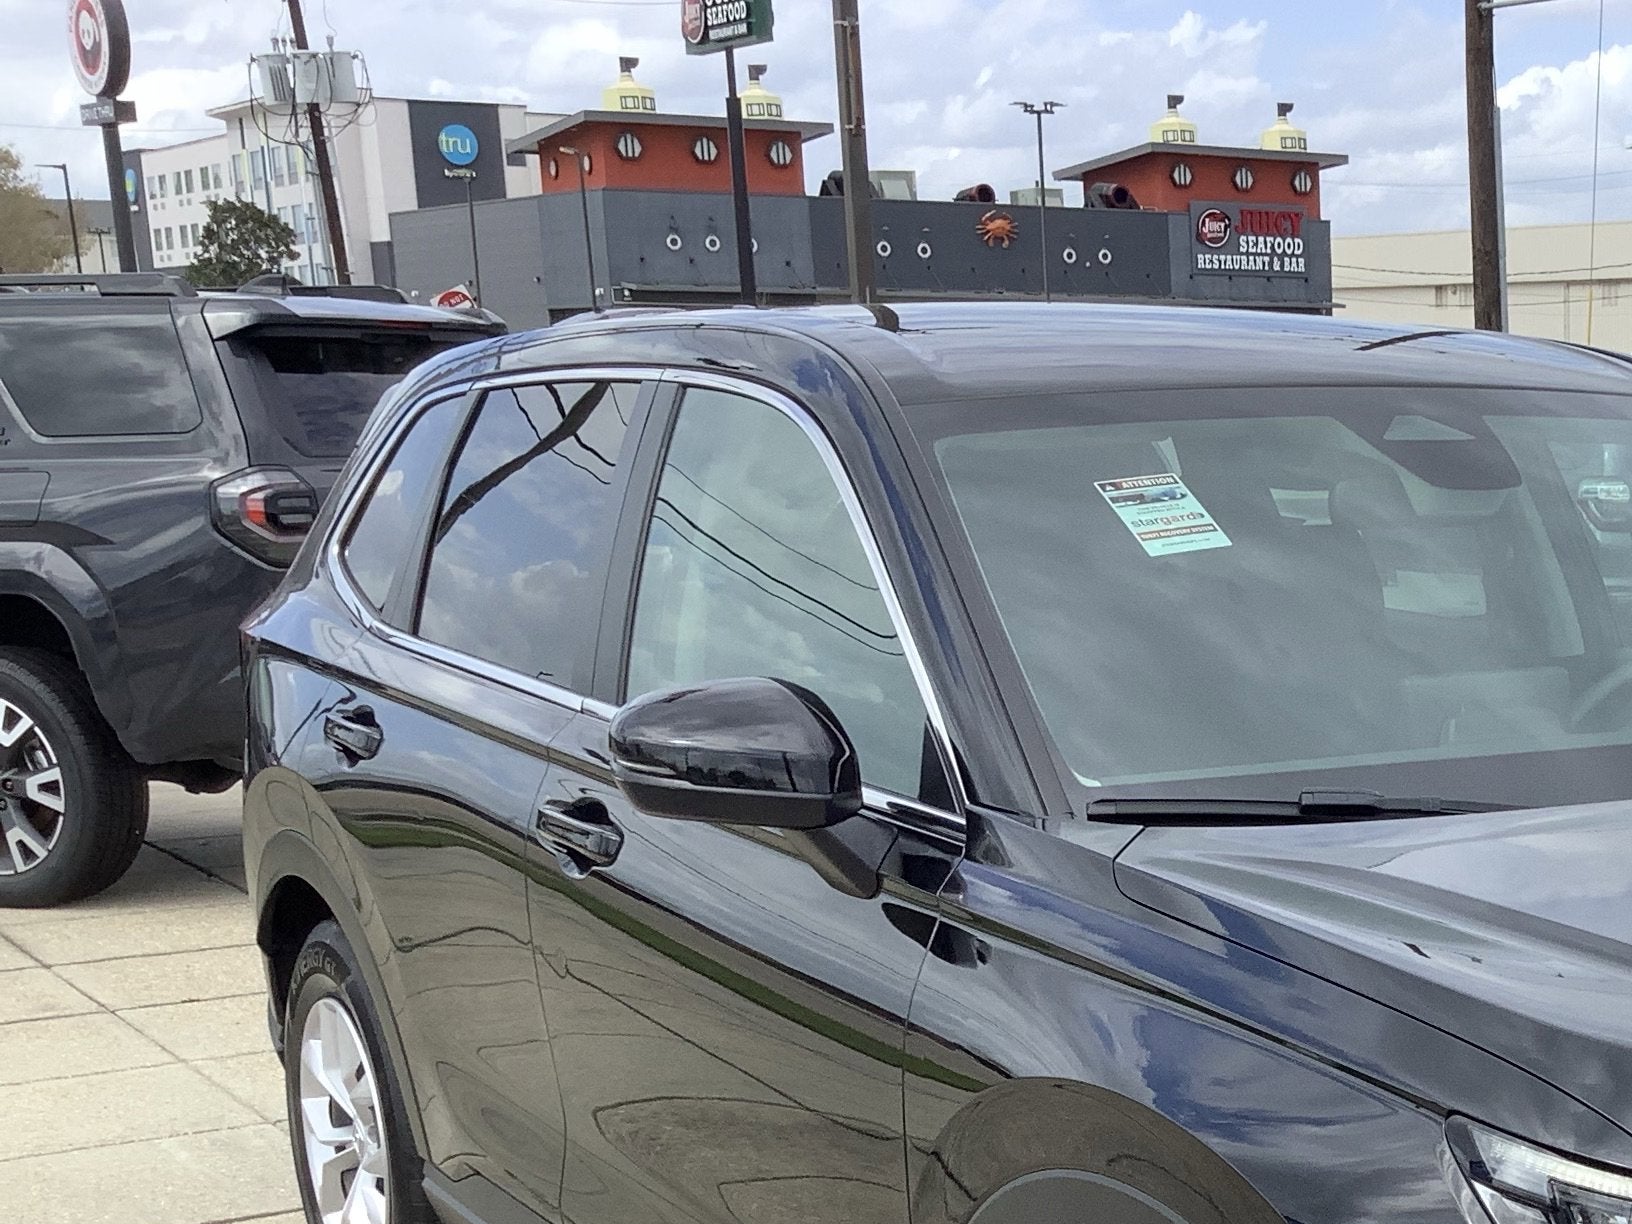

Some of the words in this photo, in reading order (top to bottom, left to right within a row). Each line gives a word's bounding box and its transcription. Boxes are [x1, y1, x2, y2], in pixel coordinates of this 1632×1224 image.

[706, 0, 747, 26] SEAFOOD
[442, 132, 471, 154] tru
[1235, 209, 1304, 236] JUICY
[1240, 235, 1303, 255] SEAFOOD
[1197, 254, 1270, 271] RESTAURANT
[1273, 257, 1280, 271] &
[1283, 257, 1305, 272] BAR
[1121, 476, 1175, 490] ATTENTION
[1131, 511, 1197, 527] stargard
